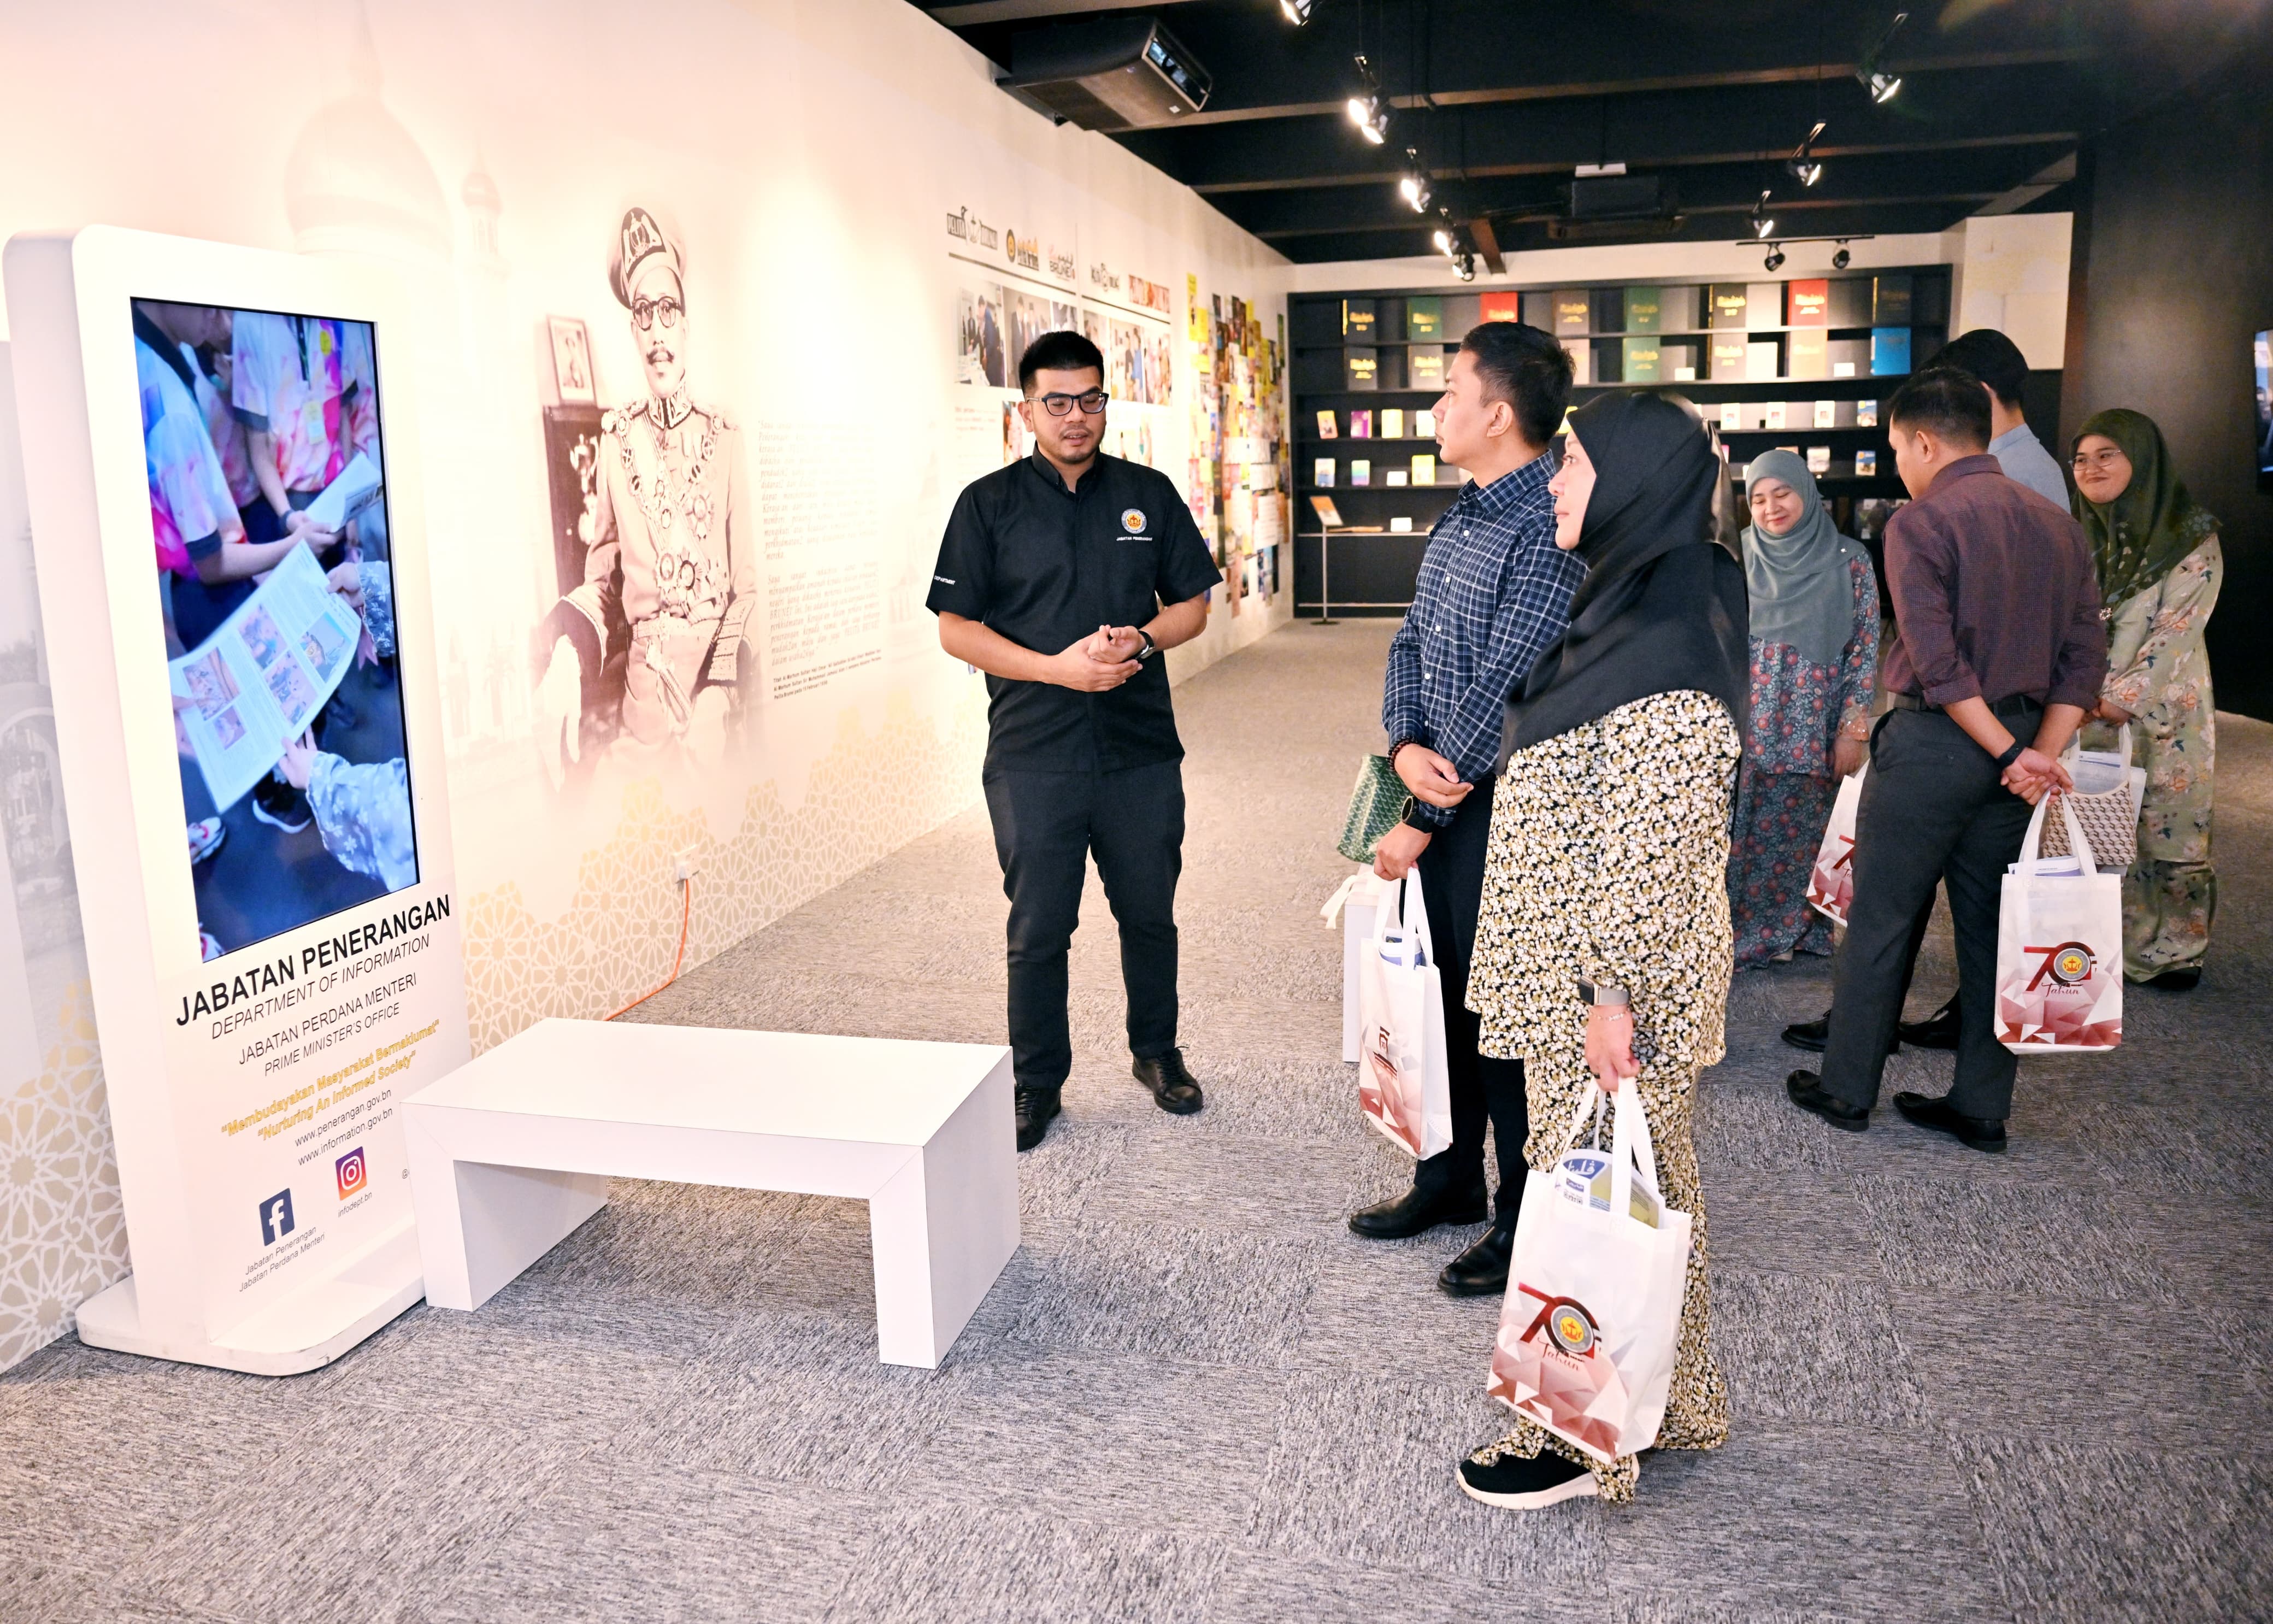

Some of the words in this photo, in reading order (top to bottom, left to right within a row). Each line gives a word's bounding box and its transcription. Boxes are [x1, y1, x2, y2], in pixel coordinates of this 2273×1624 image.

[176, 955, 295, 1026] JABATAN
[302, 894, 450, 975] PENERANGAN
[212, 981, 315, 1039] DEPARTMENT
[320, 972, 337, 992] OF
[343, 933, 429, 983] INFORMATION
[239, 1025, 298, 1064] JABATAN
[302, 997, 363, 1035] PERDANA
[366, 972, 416, 1007] MENTERI
[265, 1049, 299, 1076] PRIME
[303, 1020, 362, 1058] MINISTER'S
[364, 1002, 399, 1028] OFFICE
[315, 1097, 330, 1114] An
[333, 1071, 376, 1104] Informed
[317, 1052, 374, 1091] Masyarakat
[295, 1089, 392, 1147] www.penerangan.gov.bn
[298, 1108, 393, 1166] www.information.gov.bn
[338, 1192, 373, 1218] infodept.bn
[239, 1269, 268, 1292] Jabatan
[269, 1250, 299, 1273] Perdana
[300, 1231, 325, 1254] Menteri
[245, 1252, 274, 1275] Jabatan
[275, 1226, 316, 1256] Penerangan
